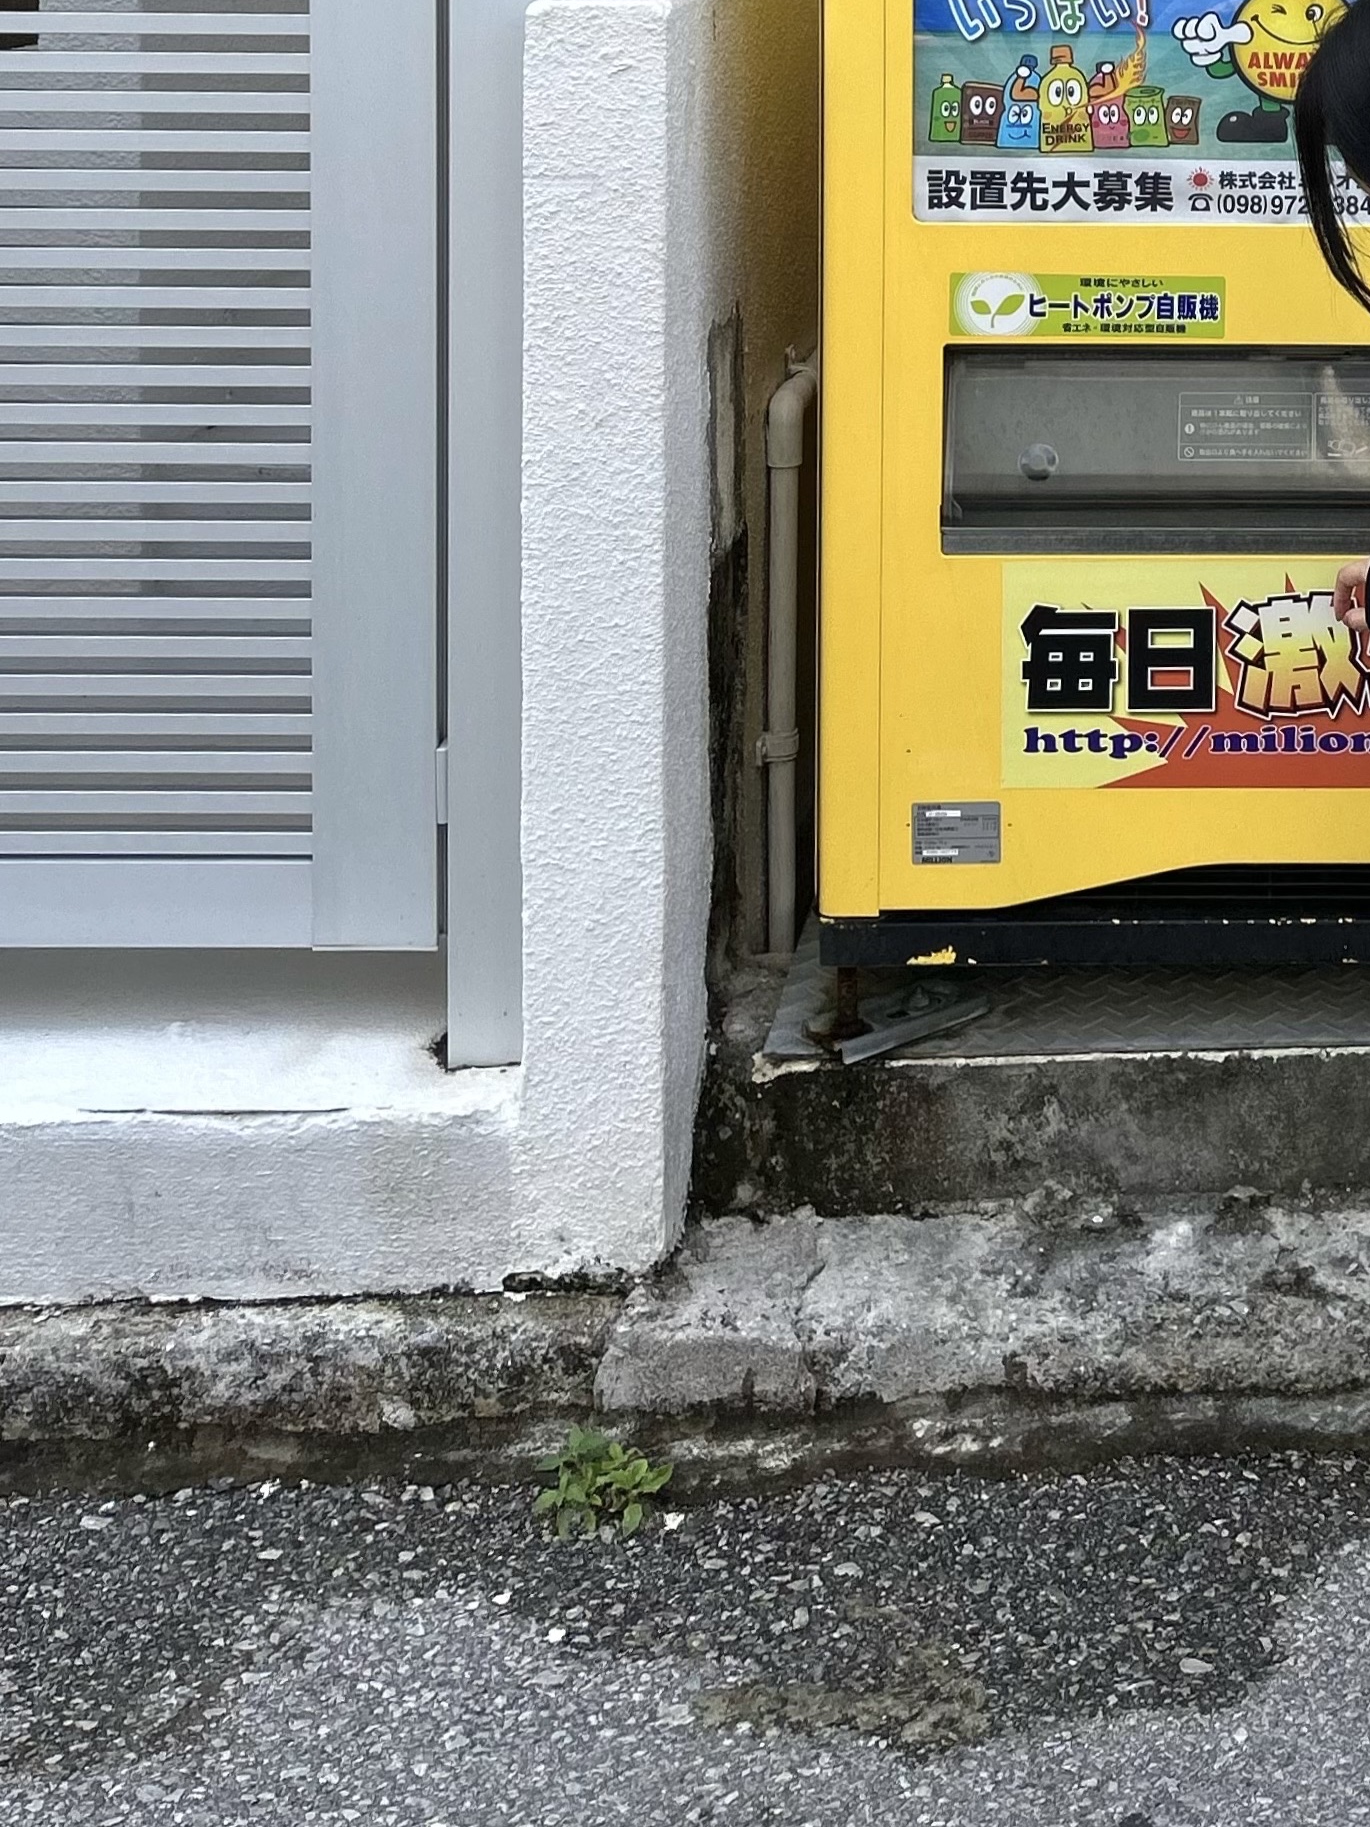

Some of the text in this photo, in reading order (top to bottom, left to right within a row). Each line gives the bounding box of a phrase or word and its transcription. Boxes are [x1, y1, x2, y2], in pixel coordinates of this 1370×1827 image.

[1248, 51, 1314, 70] ALWA
[1042, 123, 1090, 134] ENERGY
[1045, 135, 1086, 146] DRINK
[927, 169, 1175, 213] 設置先大募集
[1080, 278, 1164, 288] 環境にやさしい
[1029, 292, 1219, 320] ヒートポンプ自販機
